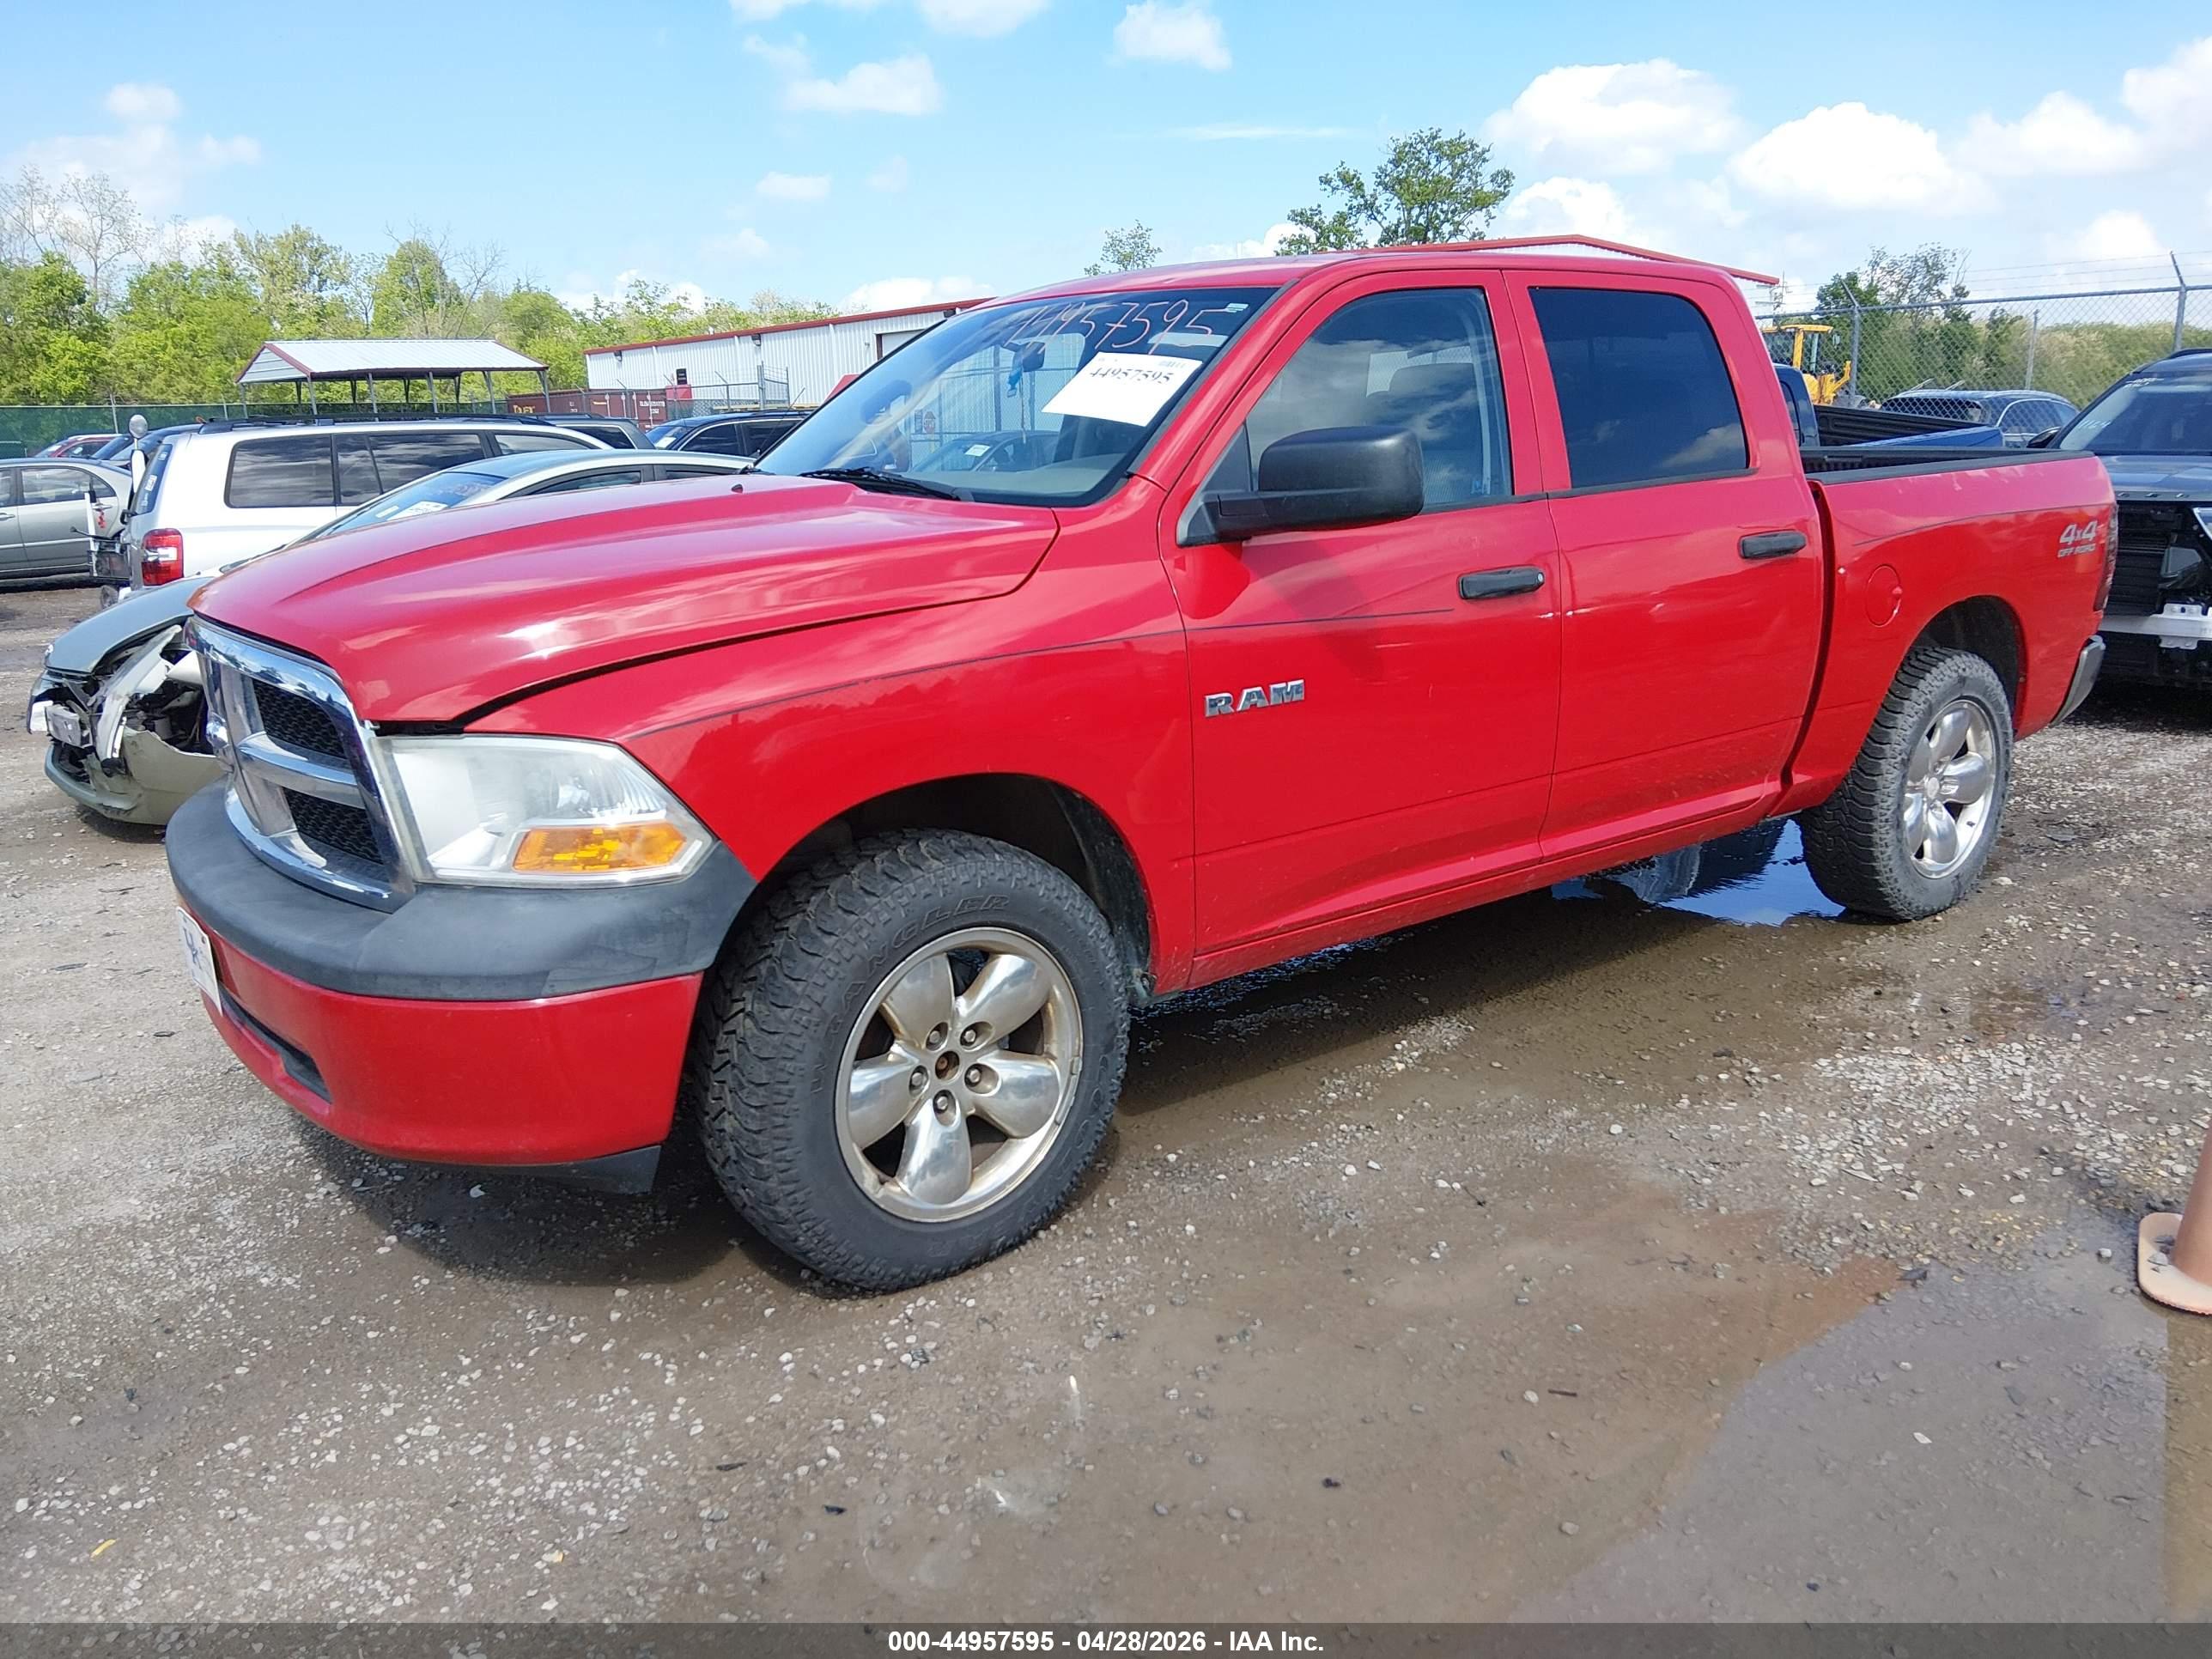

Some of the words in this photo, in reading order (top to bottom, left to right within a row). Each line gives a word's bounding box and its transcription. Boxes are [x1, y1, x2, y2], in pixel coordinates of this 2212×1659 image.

[1089, 367, 1175, 384] 44957595
[2058, 520, 2098, 545] 4x4
[1204, 679, 1304, 718] RAM
[810, 894, 1009, 1095] WRANGLER
